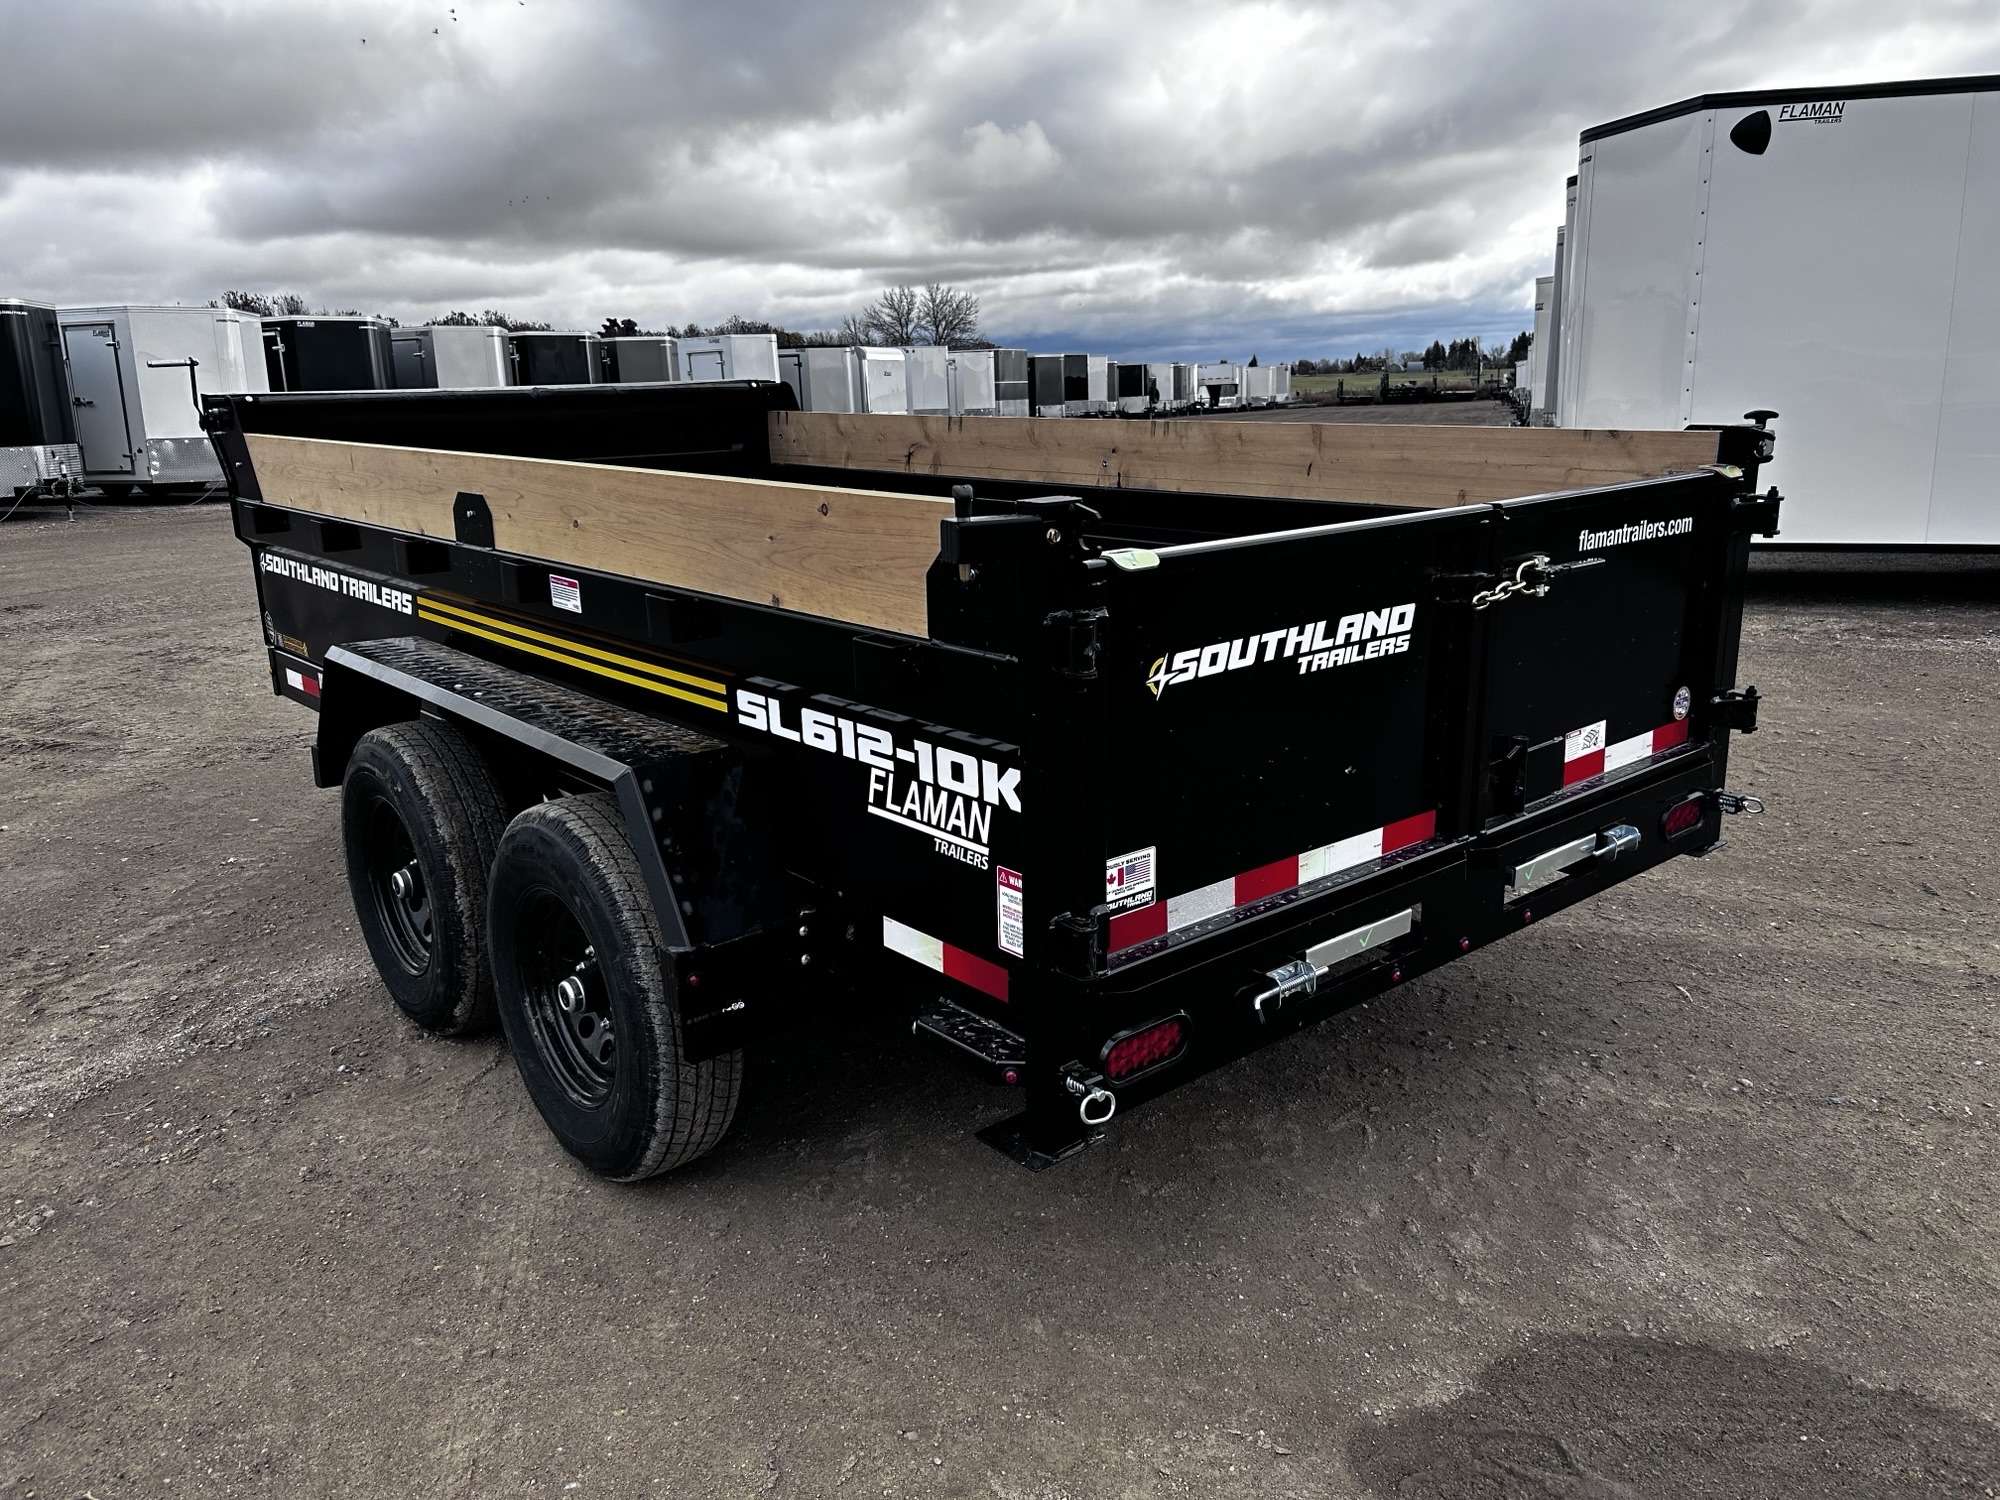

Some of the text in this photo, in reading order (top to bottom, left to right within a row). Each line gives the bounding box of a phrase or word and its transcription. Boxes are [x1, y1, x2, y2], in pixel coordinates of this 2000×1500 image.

[1780, 102, 1845, 118] FLAMAN
[1579, 517, 1693, 551] flamantrailers.com
[265, 554, 412, 614] SOUTHLAND TRAILERS
[1169, 603, 1416, 684] SOUTHLAND
[1298, 634, 1411, 674] TRAILERS
[737, 689, 1021, 813] SL612-10K
[868, 767, 991, 844] FLAMAN
[934, 838, 989, 870] TRAILERS
